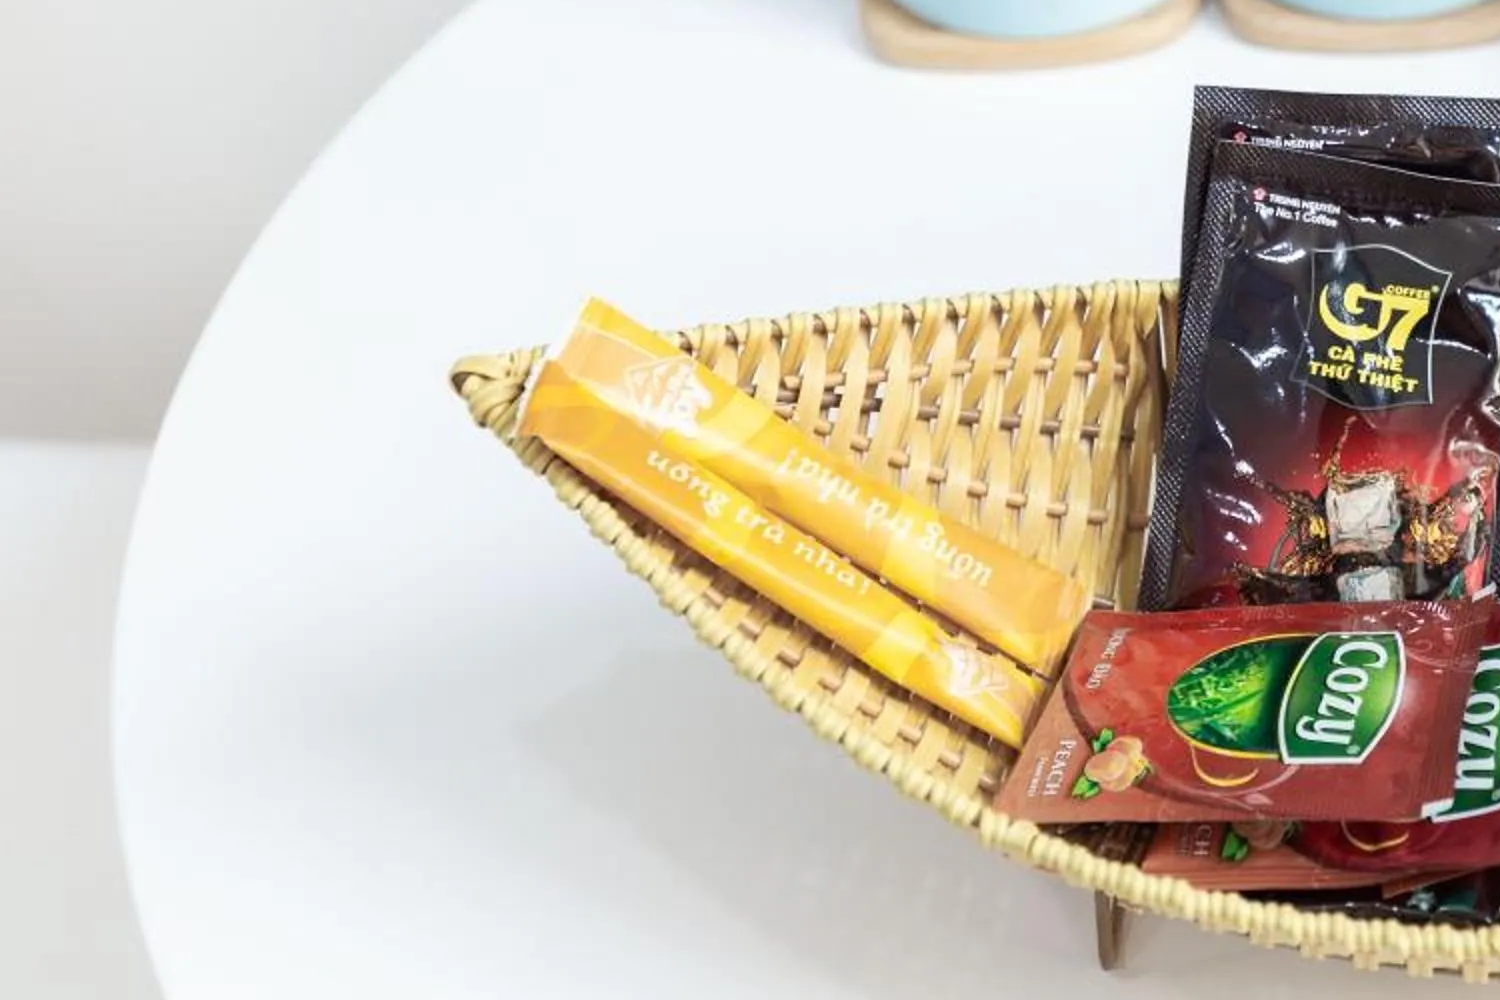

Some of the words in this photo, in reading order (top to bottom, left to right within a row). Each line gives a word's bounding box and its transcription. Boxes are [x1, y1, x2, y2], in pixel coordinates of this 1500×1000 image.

[1302, 211, 1339, 228] Coffee
[1319, 282, 1430, 351] G7
[1384, 284, 1431, 300] COFFEE
[1296, 641, 1388, 745] Cozy
[1043, 738, 1078, 796] PEACH
